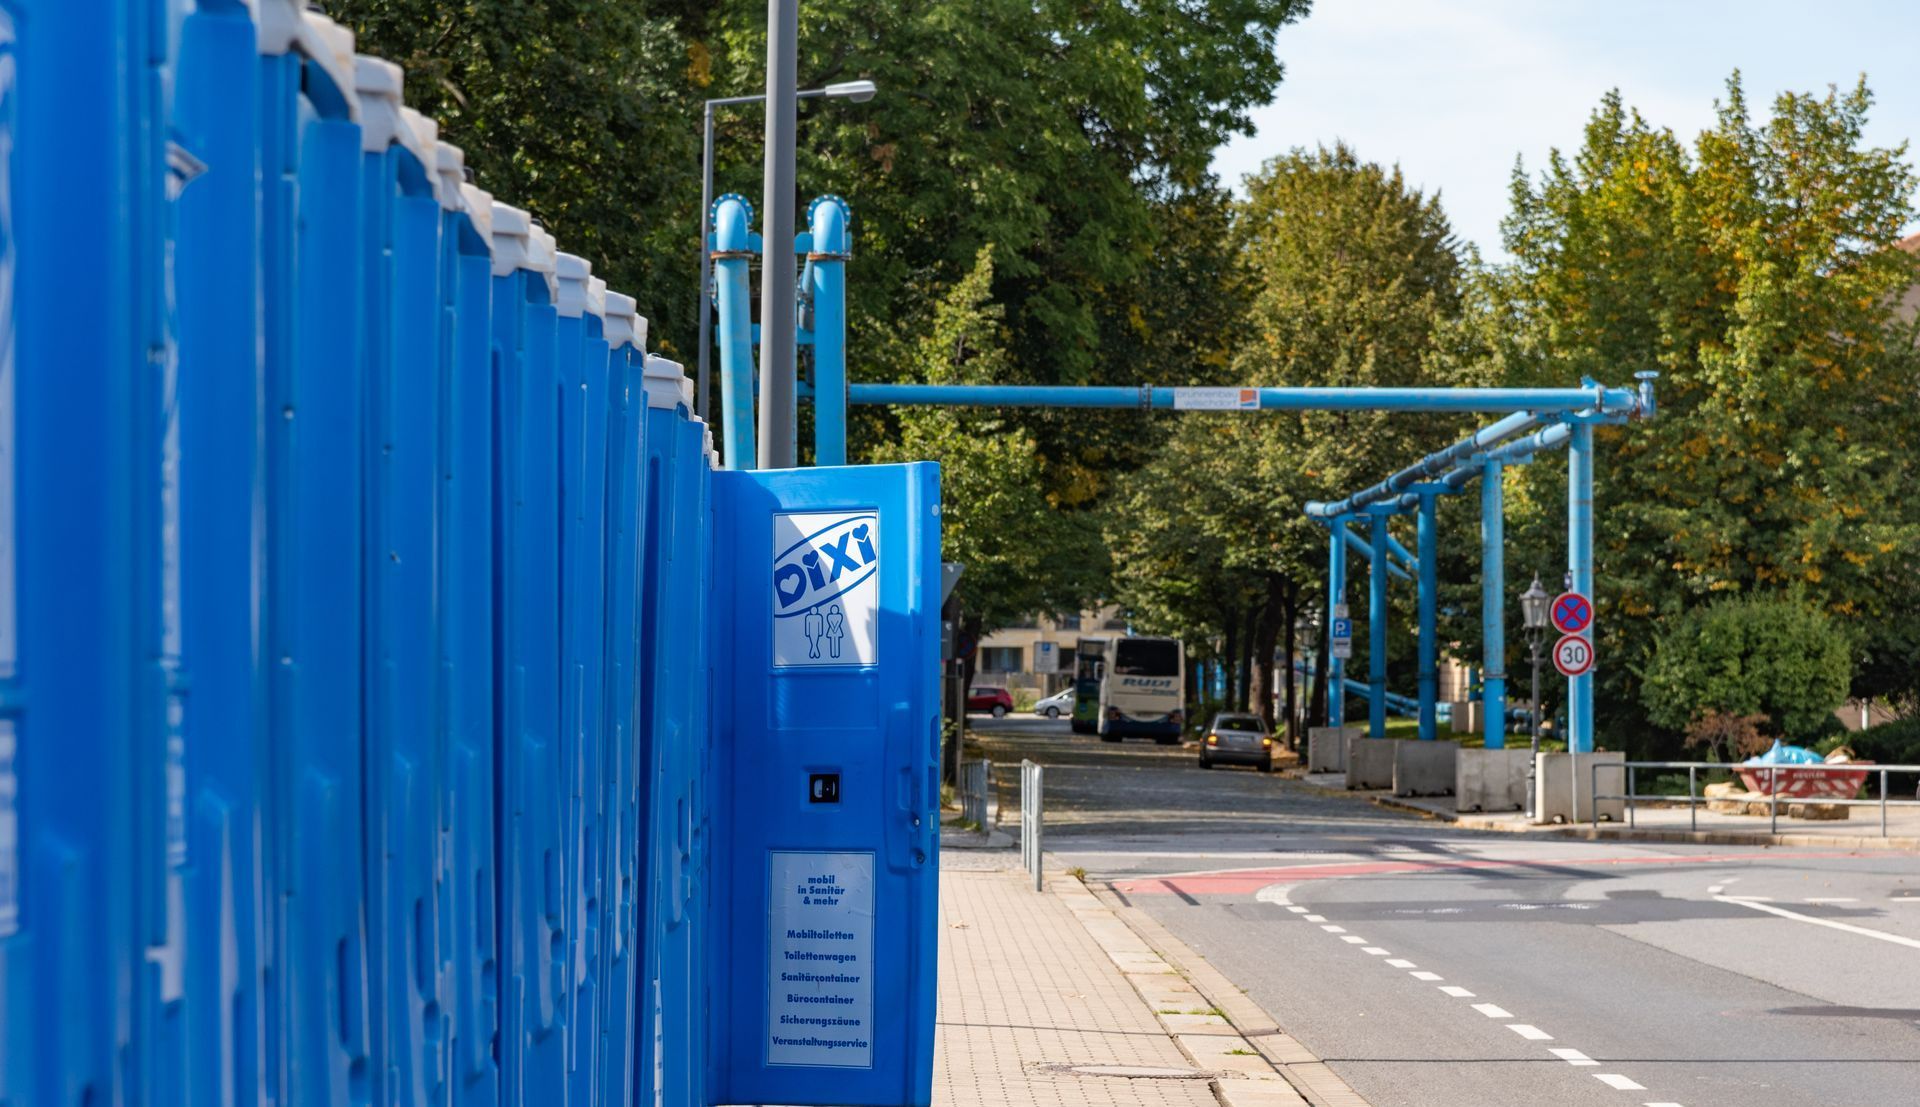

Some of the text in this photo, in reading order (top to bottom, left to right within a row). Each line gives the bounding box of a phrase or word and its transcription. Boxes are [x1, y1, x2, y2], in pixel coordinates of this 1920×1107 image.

[1562, 646, 1585, 664] 30
[808, 875, 835, 884] mobil
[797, 885, 845, 895] in Sanitär
[803, 896, 839, 905] & mehr
[787, 929, 854, 940] Mobiltoiletten
[784, 951, 857, 963] Toilettenwagen
[781, 972, 860, 983] Sanitärcontainer
[787, 993, 854, 1004] Bürocontainer
[780, 1014, 861, 1027] Sicherungszäune
[772, 1036, 868, 1049] Veranstaltungsservice
